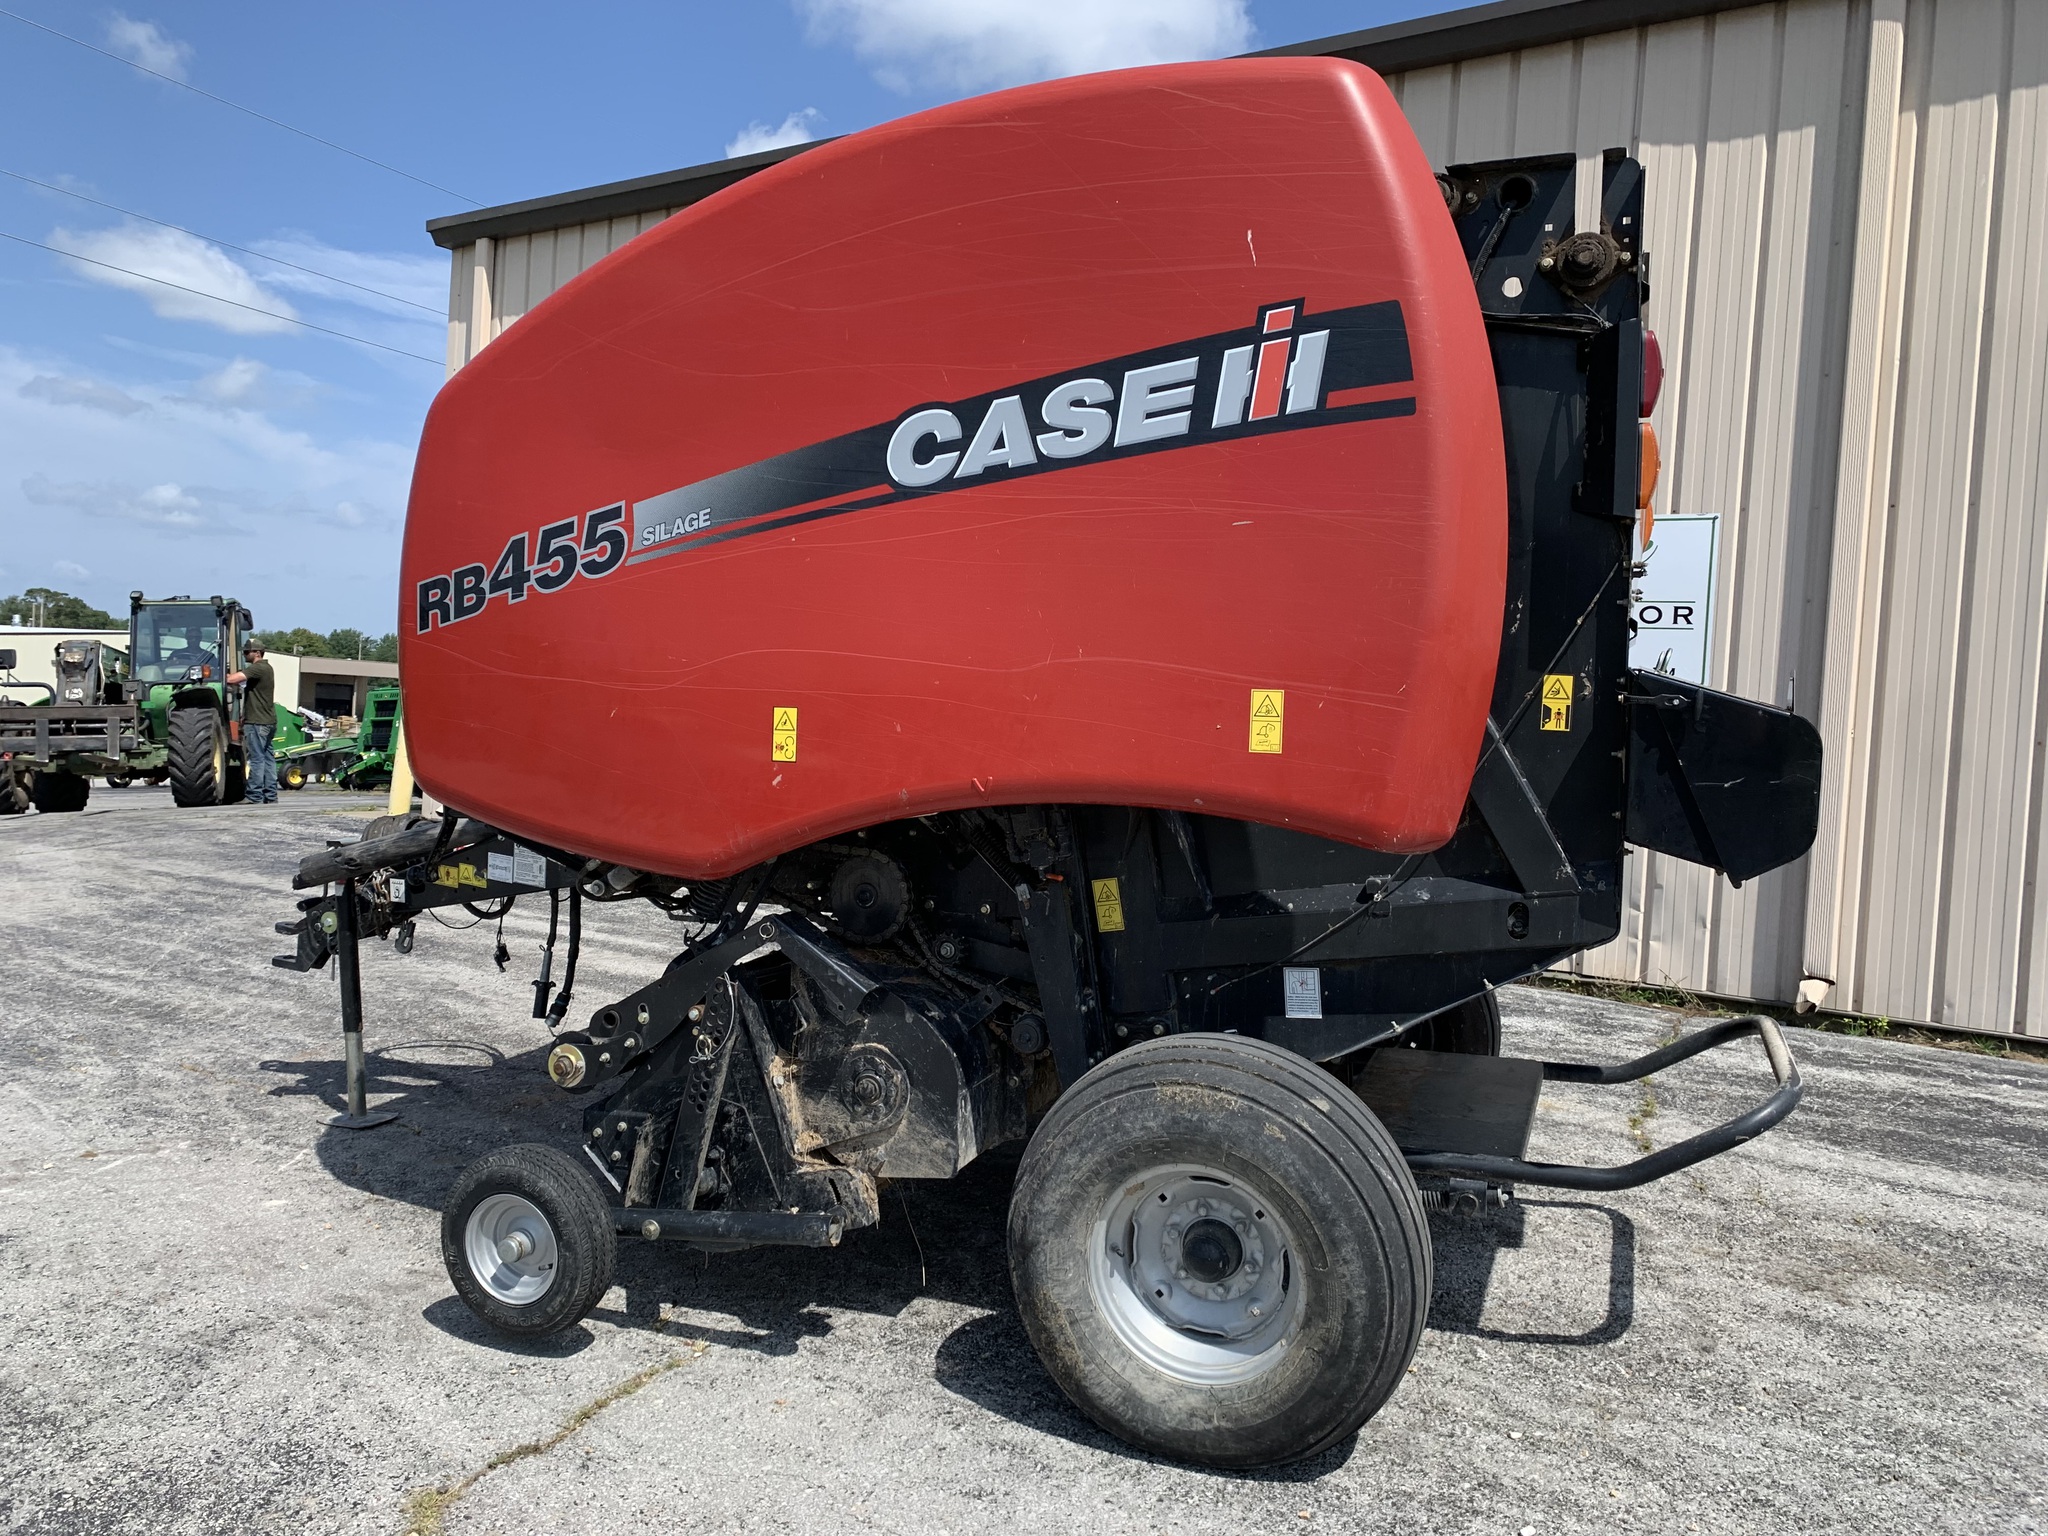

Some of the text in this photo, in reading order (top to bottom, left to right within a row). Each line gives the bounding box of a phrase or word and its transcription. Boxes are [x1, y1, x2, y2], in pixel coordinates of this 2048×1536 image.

[887, 357, 1199, 487] CASE
[417, 500, 711, 635] RB455 SILAGE
[495, 1171, 571, 1239] CARLISLE
